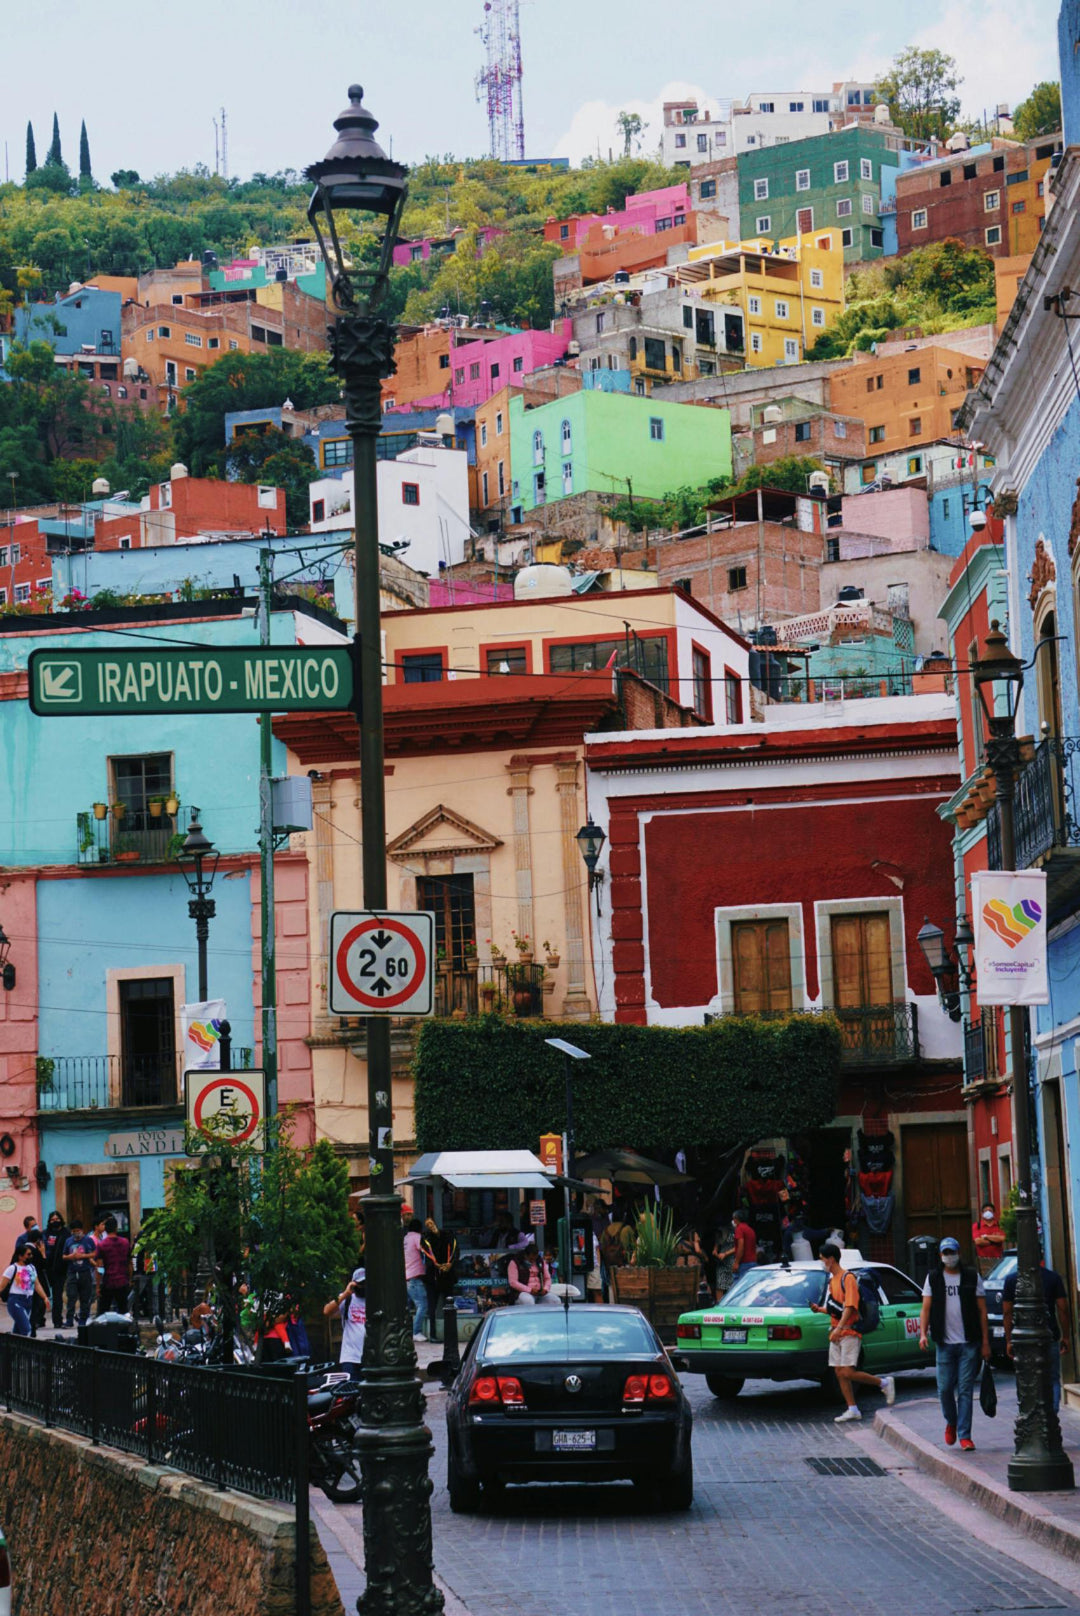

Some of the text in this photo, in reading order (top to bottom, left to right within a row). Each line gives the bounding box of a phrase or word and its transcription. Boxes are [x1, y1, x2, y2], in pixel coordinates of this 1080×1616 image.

[98, 660, 223, 702] IRAPUATO
[244, 657, 340, 700] MEXICO
[359, 948, 409, 978] 2 60
[220, 1089, 234, 1106] E
[137, 1130, 167, 1142] FOTO
